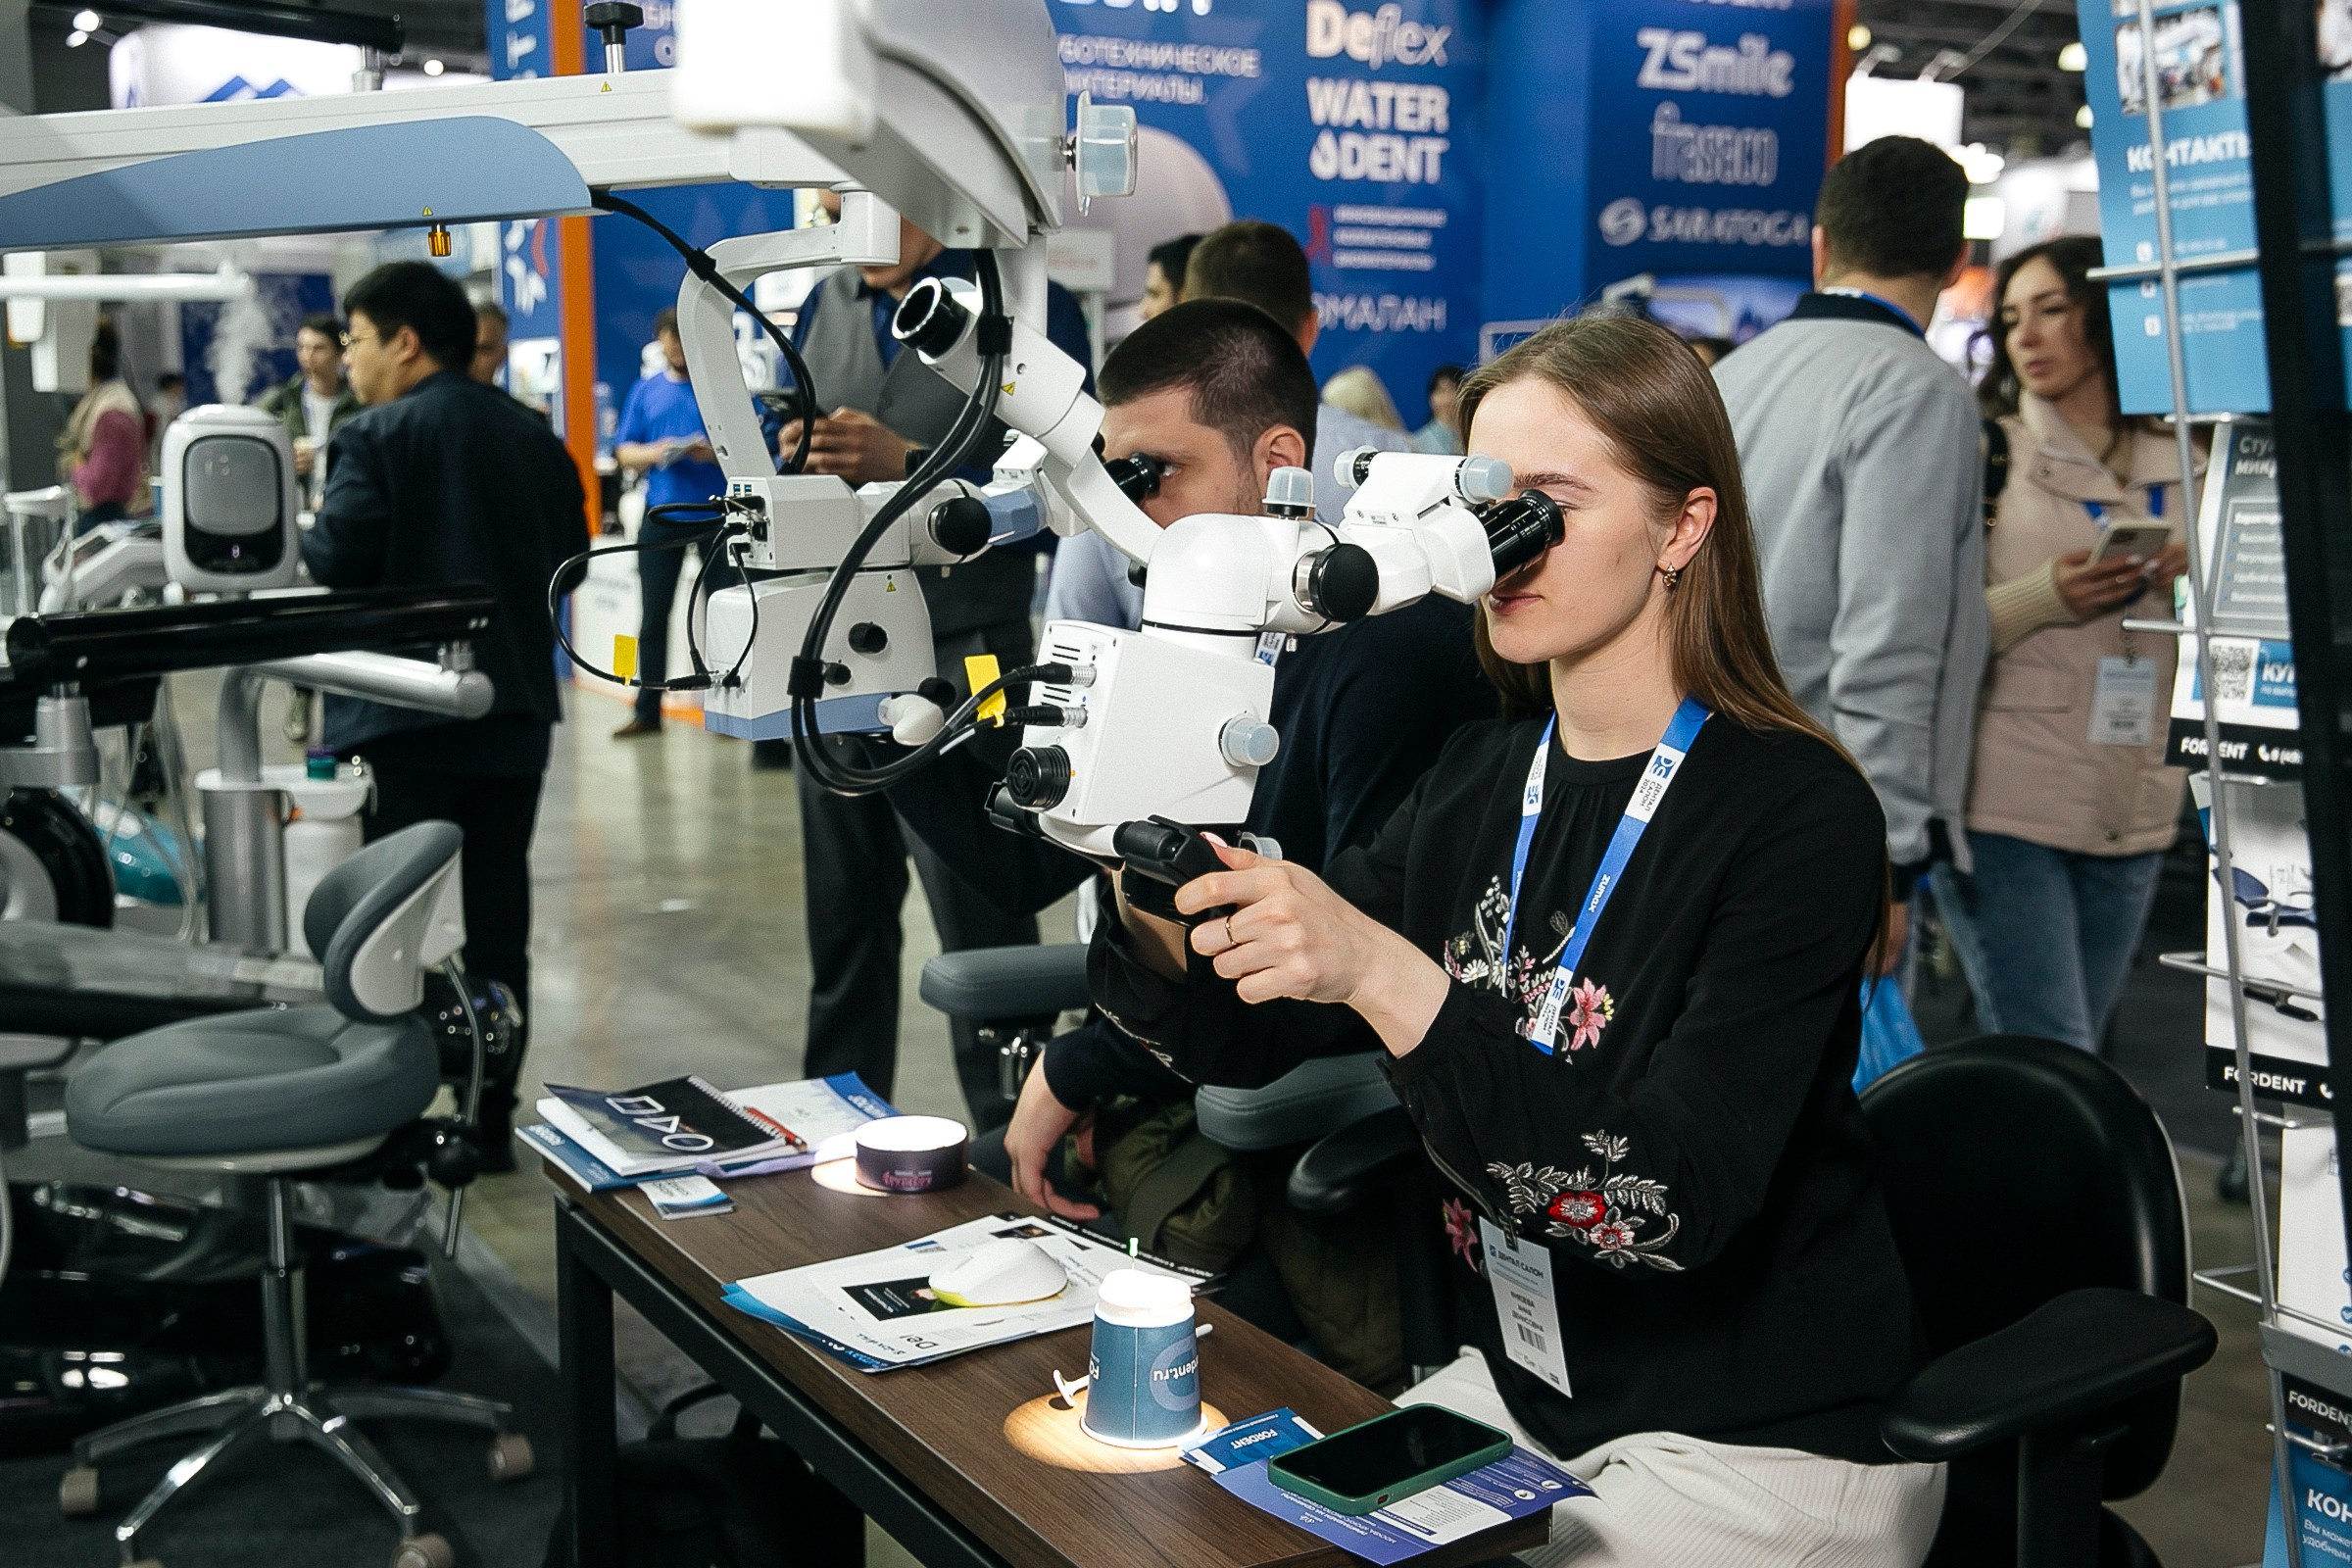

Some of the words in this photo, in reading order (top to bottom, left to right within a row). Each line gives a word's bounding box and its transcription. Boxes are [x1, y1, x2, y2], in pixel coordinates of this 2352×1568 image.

[1306, 0, 1452, 70] Deflex
[1636, 25, 1795, 98] ZSmile
[1305, 76, 1450, 134] WATER
[1647, 204, 1811, 246] SARATOGA
[2180, 736, 2249, 760] FORENT
[1588, 874, 1611, 913] zumax
[1232, 1429, 1278, 1450] FORDENT
[2304, 1519, 2321, 1535] Вы
